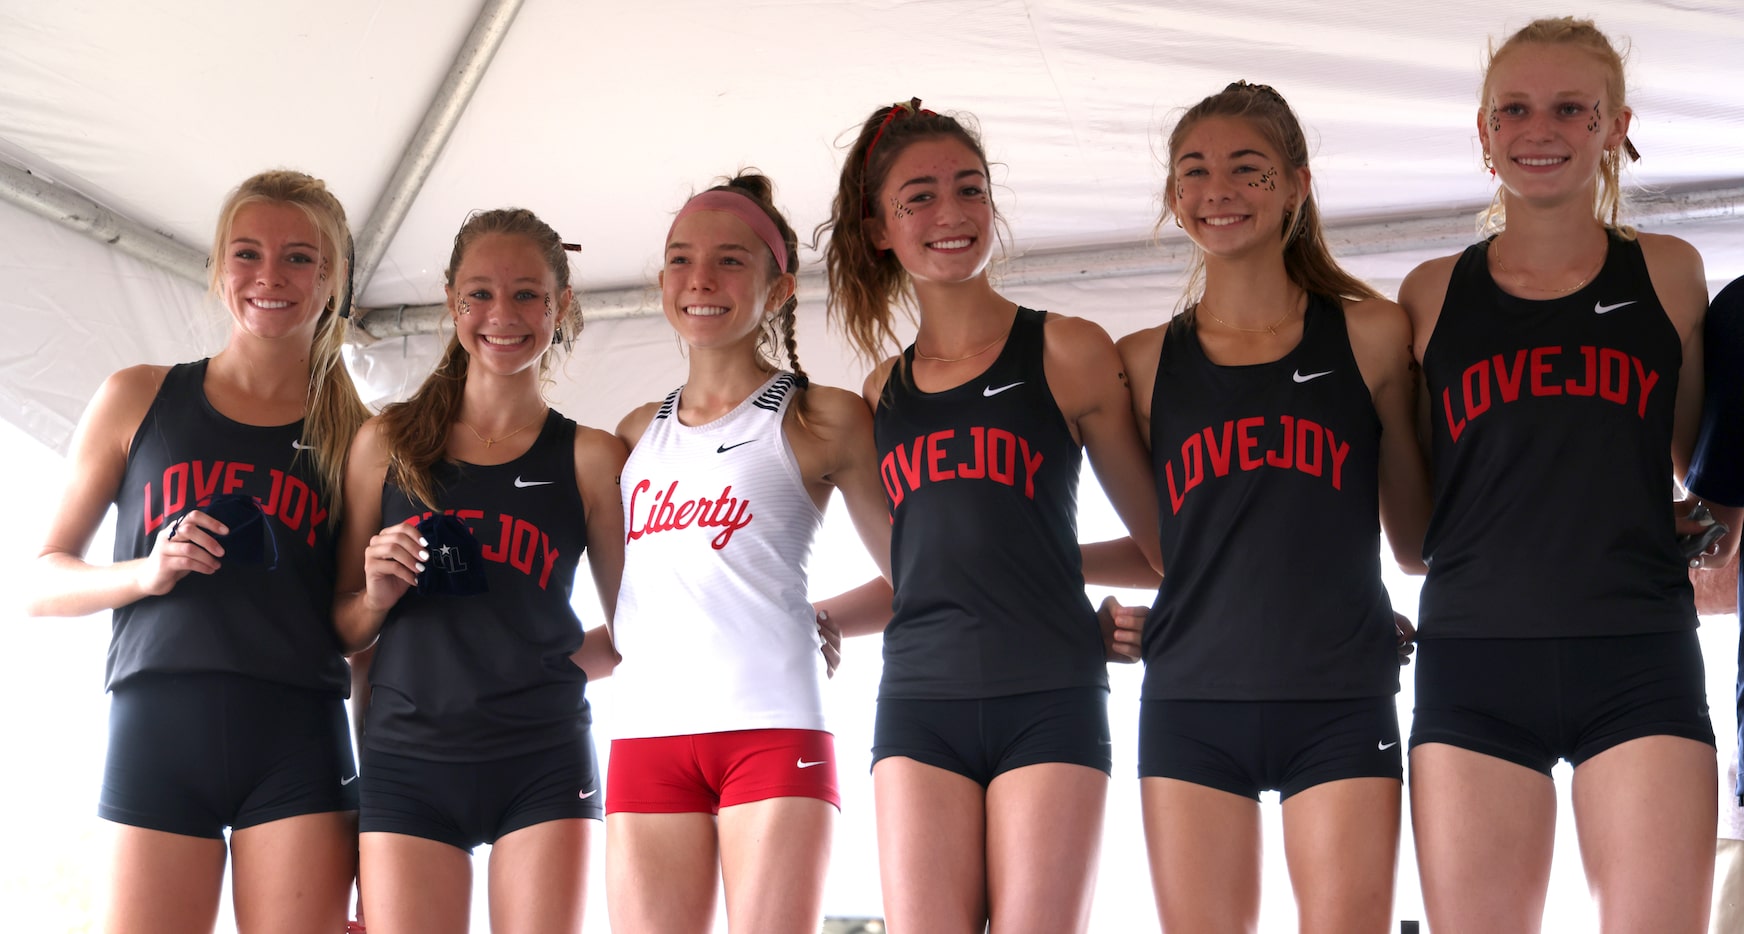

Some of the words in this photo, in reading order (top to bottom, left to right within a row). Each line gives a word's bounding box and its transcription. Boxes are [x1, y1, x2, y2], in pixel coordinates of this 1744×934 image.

[1443, 345, 1660, 444] LOVEJOY
[627, 478, 753, 551] Liberty
[880, 426, 1044, 524] OVEJOY
[1165, 416, 1350, 516] LOVEJOY
